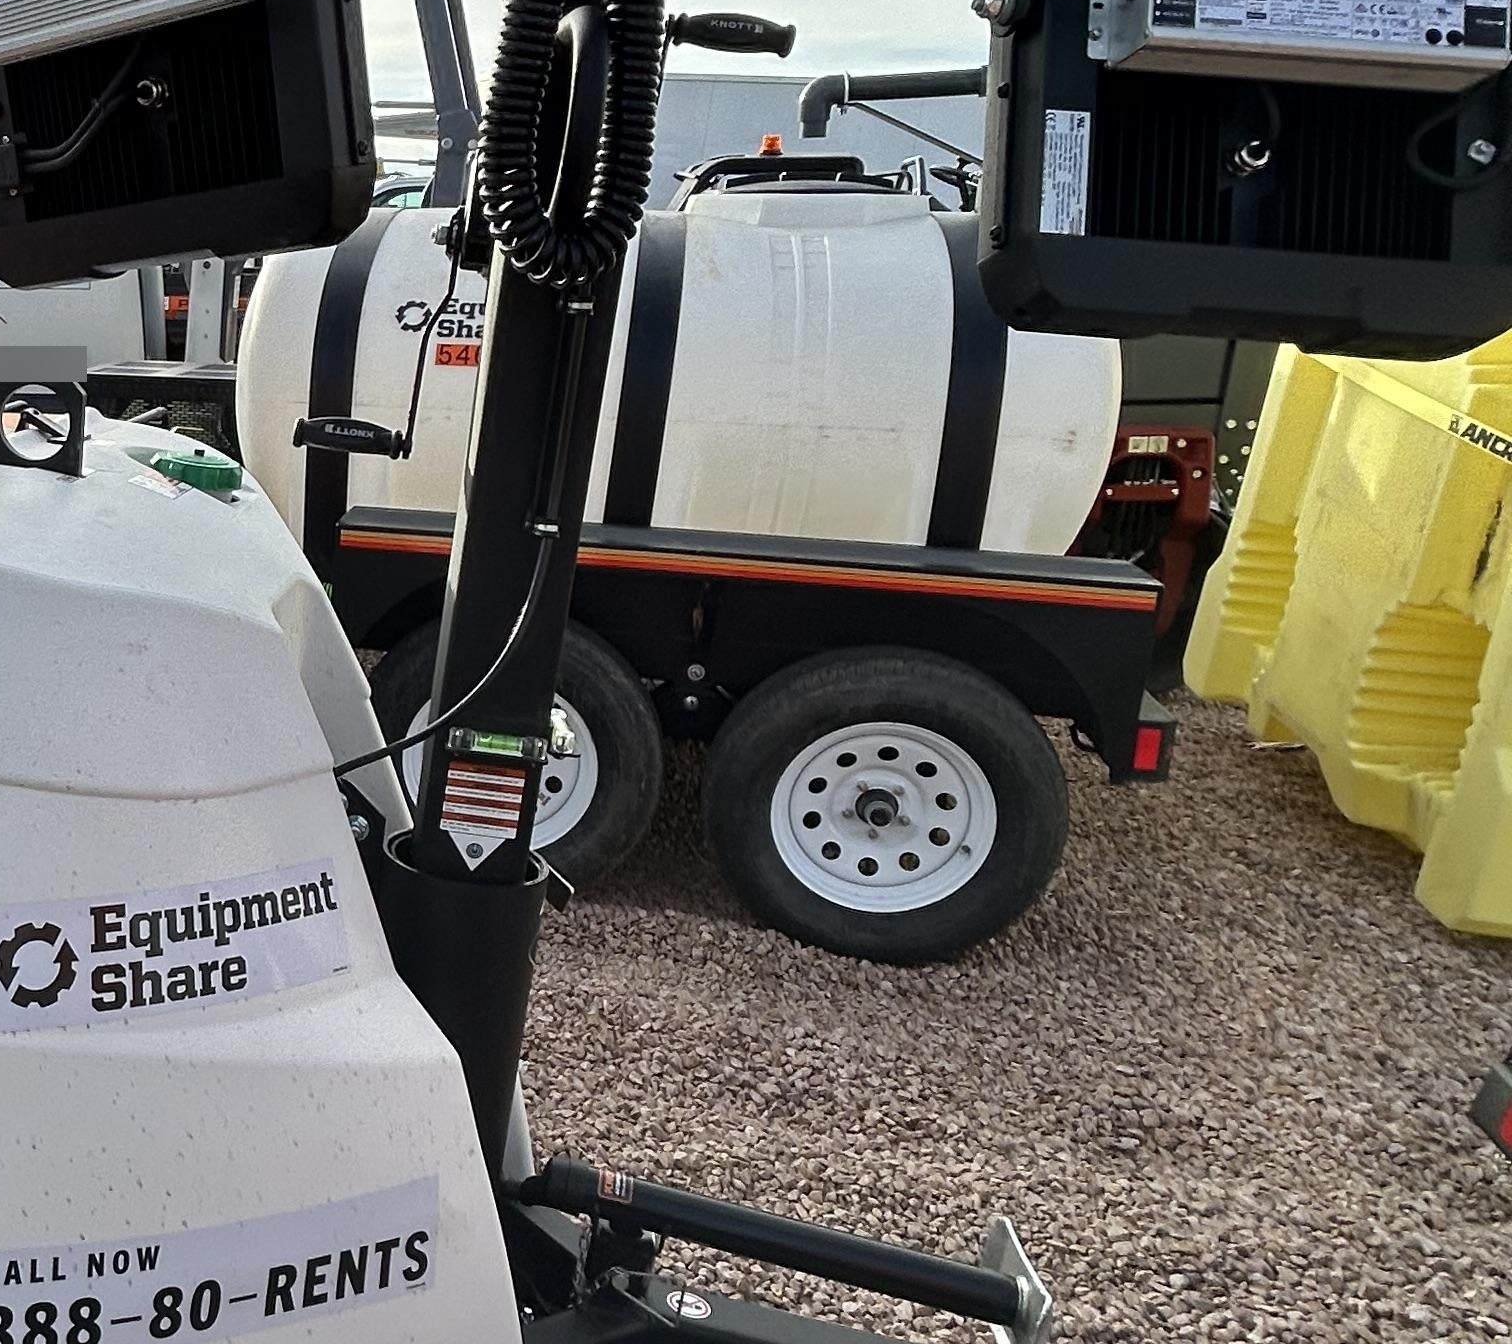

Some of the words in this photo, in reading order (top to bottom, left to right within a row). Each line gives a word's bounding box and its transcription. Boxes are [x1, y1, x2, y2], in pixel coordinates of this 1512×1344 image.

[710, 19, 753, 30] KNOTT
[335, 426, 375, 439] KNOTT
[90, 870, 337, 955] Equipment
[91, 951, 248, 1012] Share
[86, 1245, 161, 1280] NOW
